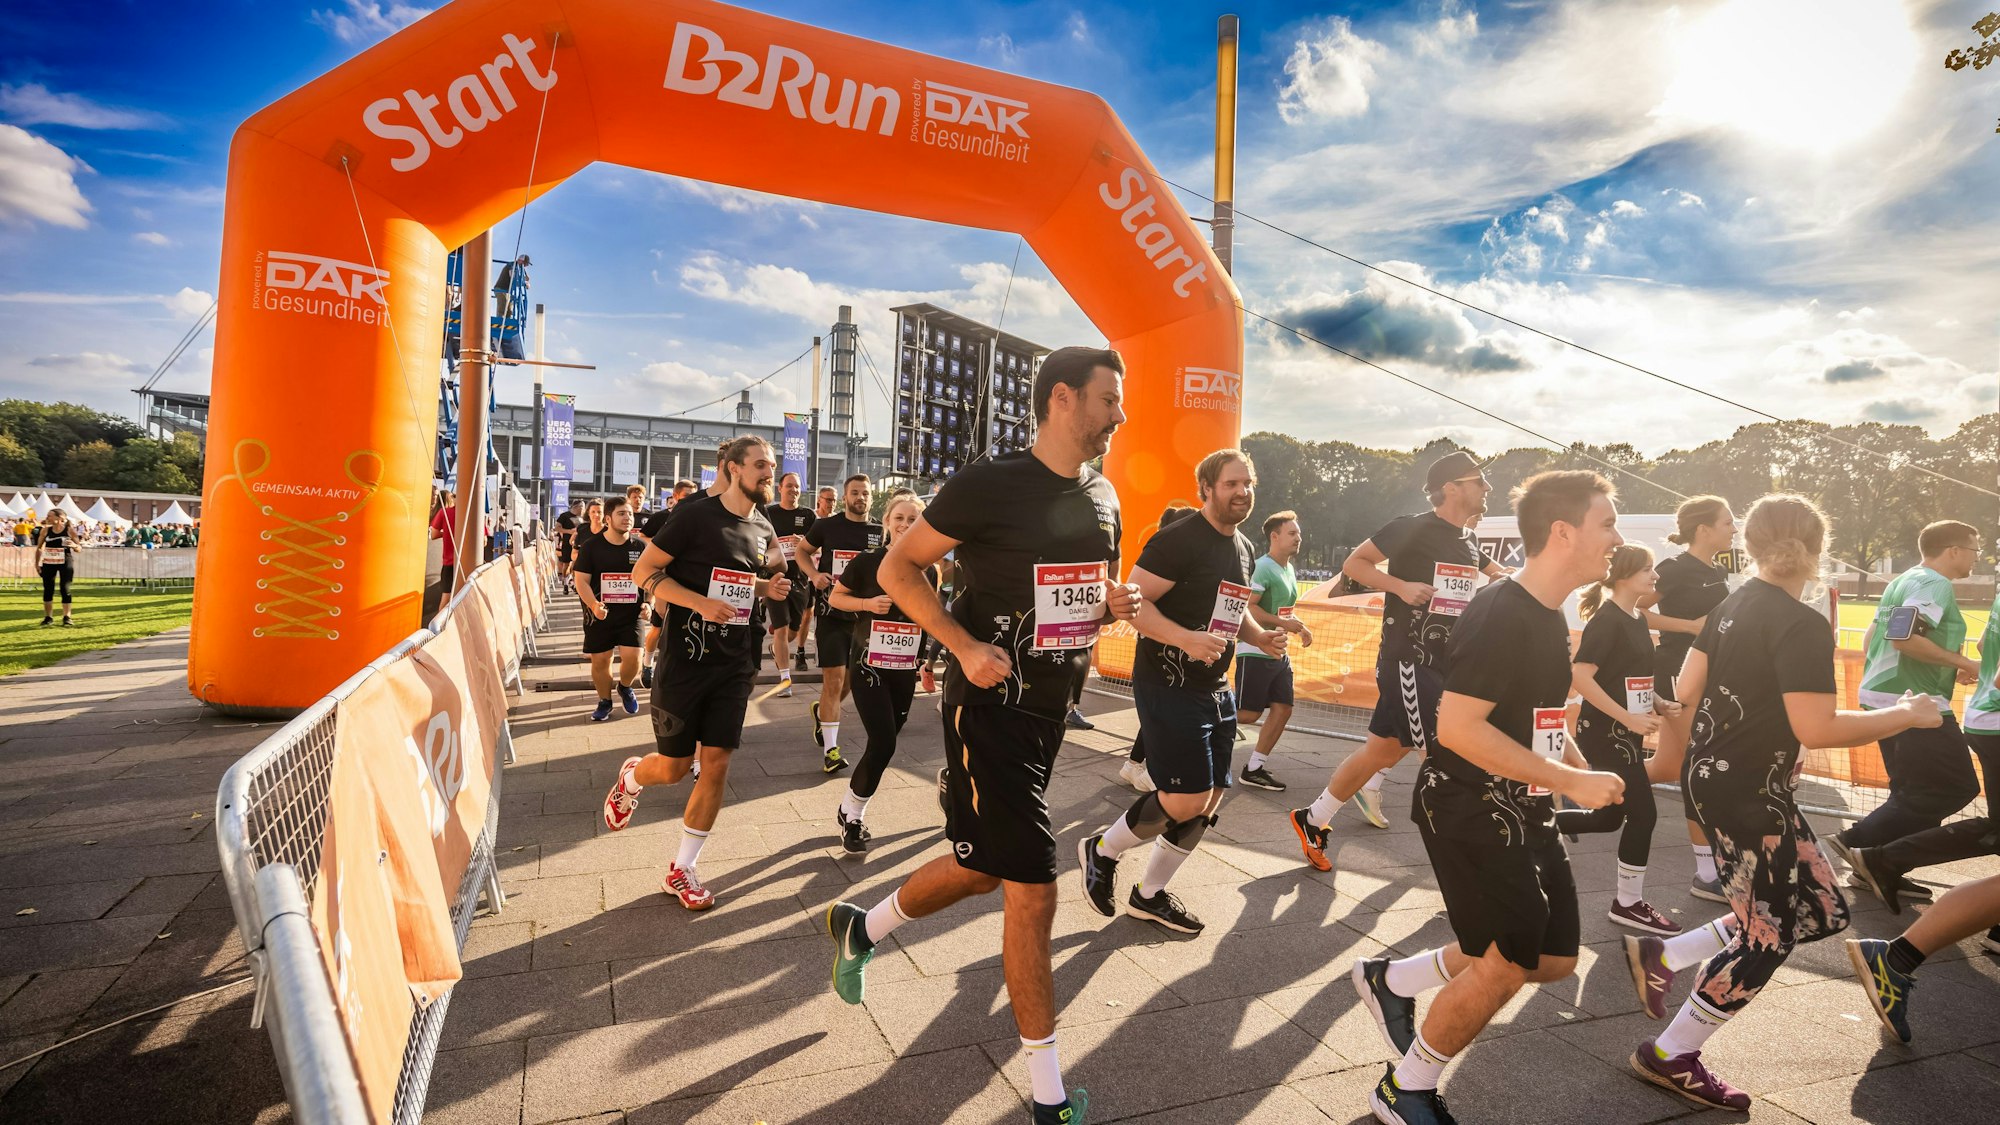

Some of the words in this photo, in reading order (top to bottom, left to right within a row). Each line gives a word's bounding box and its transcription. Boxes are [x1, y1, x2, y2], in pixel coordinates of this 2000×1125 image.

[663, 21, 901, 137] B2Run
[913, 77, 922, 89] by
[362, 33, 558, 172] Start
[910, 91, 921, 142] powered
[925, 80, 1030, 139] DAK
[922, 119, 1030, 164] Gesundheit
[1099, 167, 1207, 298] Start
[255, 250, 264, 262] by
[253, 265, 262, 309] powered
[265, 250, 391, 306] DAK
[264, 288, 390, 328] Gesundheit
[1184, 367, 1241, 400] DAK
[546, 439, 571, 447] KÖLN
[252, 482, 324, 498] GEMEINSAM.
[325, 488, 360, 500] AKTIV
[720, 584, 750, 599] 13466
[1051, 585, 1102, 607] 13462
[1444, 578, 1473, 592] 13461
[1069, 607, 1089, 615] DANIEL
[880, 634, 914, 647] 13460
[1380, 1080, 1397, 1106] HOKA
